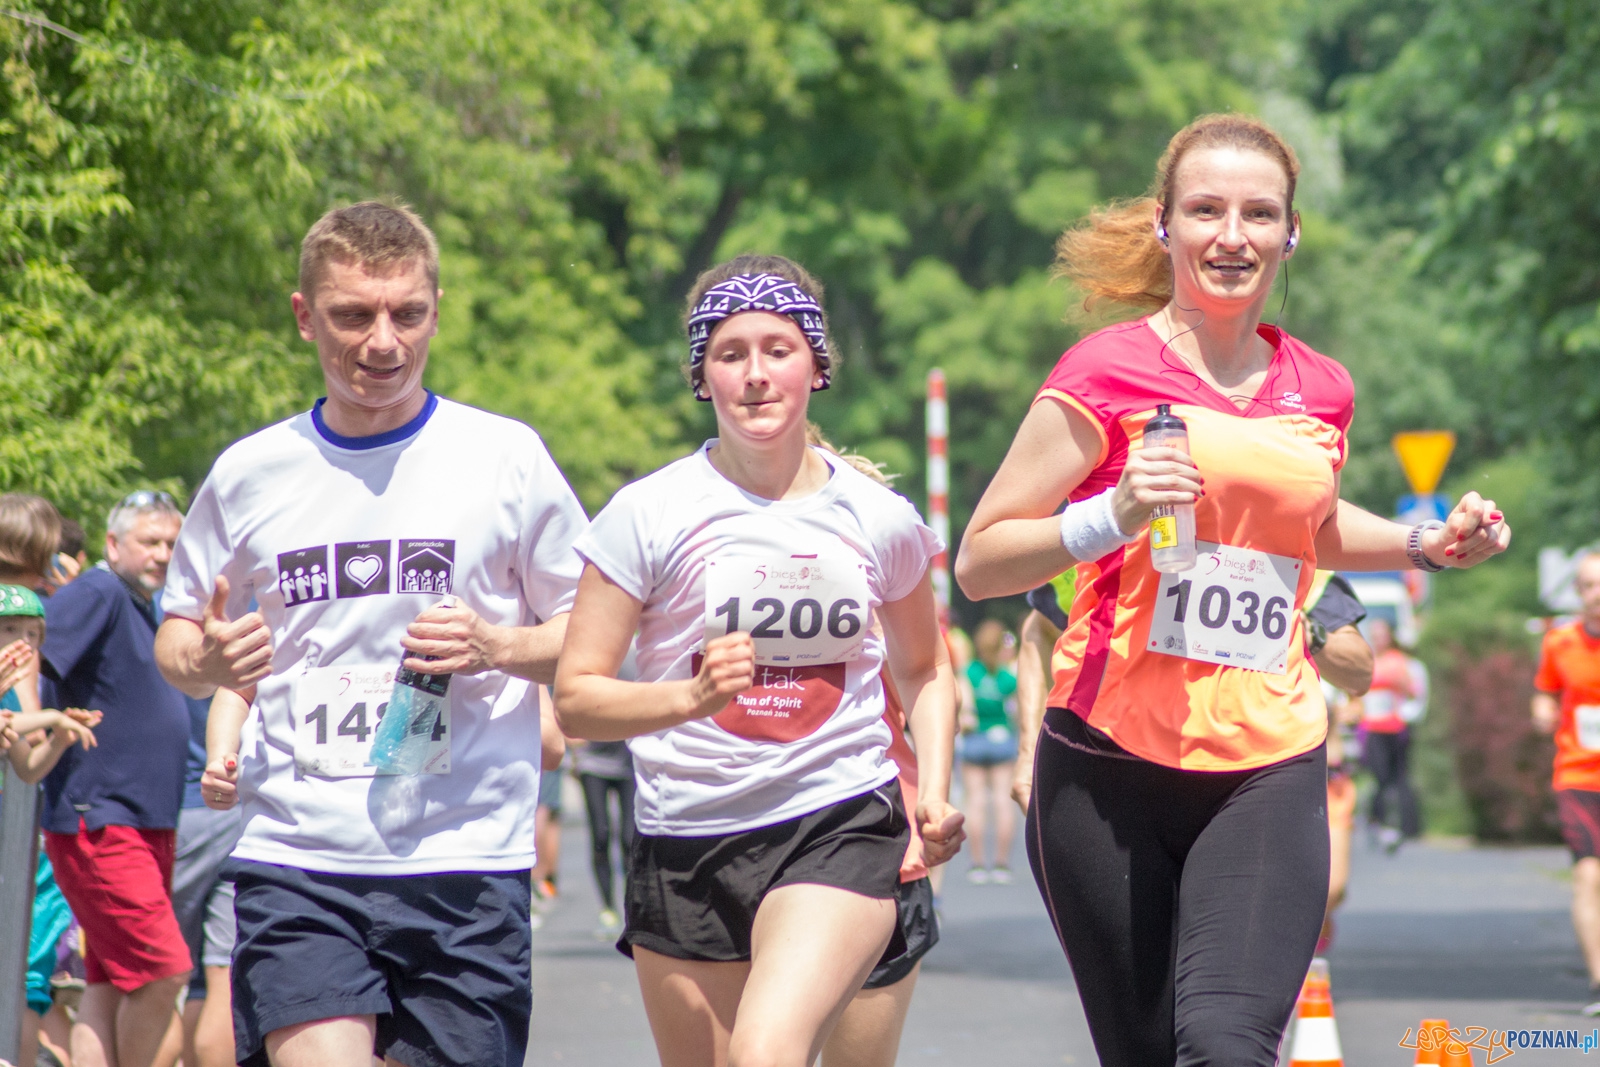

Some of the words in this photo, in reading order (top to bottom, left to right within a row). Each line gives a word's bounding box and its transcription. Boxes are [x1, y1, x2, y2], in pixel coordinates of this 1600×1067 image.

[1205, 551, 1222, 576] 5
[1223, 554, 1247, 576] bieg
[753, 565, 767, 590] 5
[770, 566, 798, 584] bieg
[715, 597, 861, 639] 1206
[1166, 579, 1289, 640] 1036
[339, 671, 351, 696] 5
[761, 667, 806, 691] tak
[736, 695, 757, 706] Run
[759, 696, 771, 706] of
[772, 696, 803, 710] Spirit
[746, 708, 773, 717] Poznań
[774, 710, 790, 718] 2016
